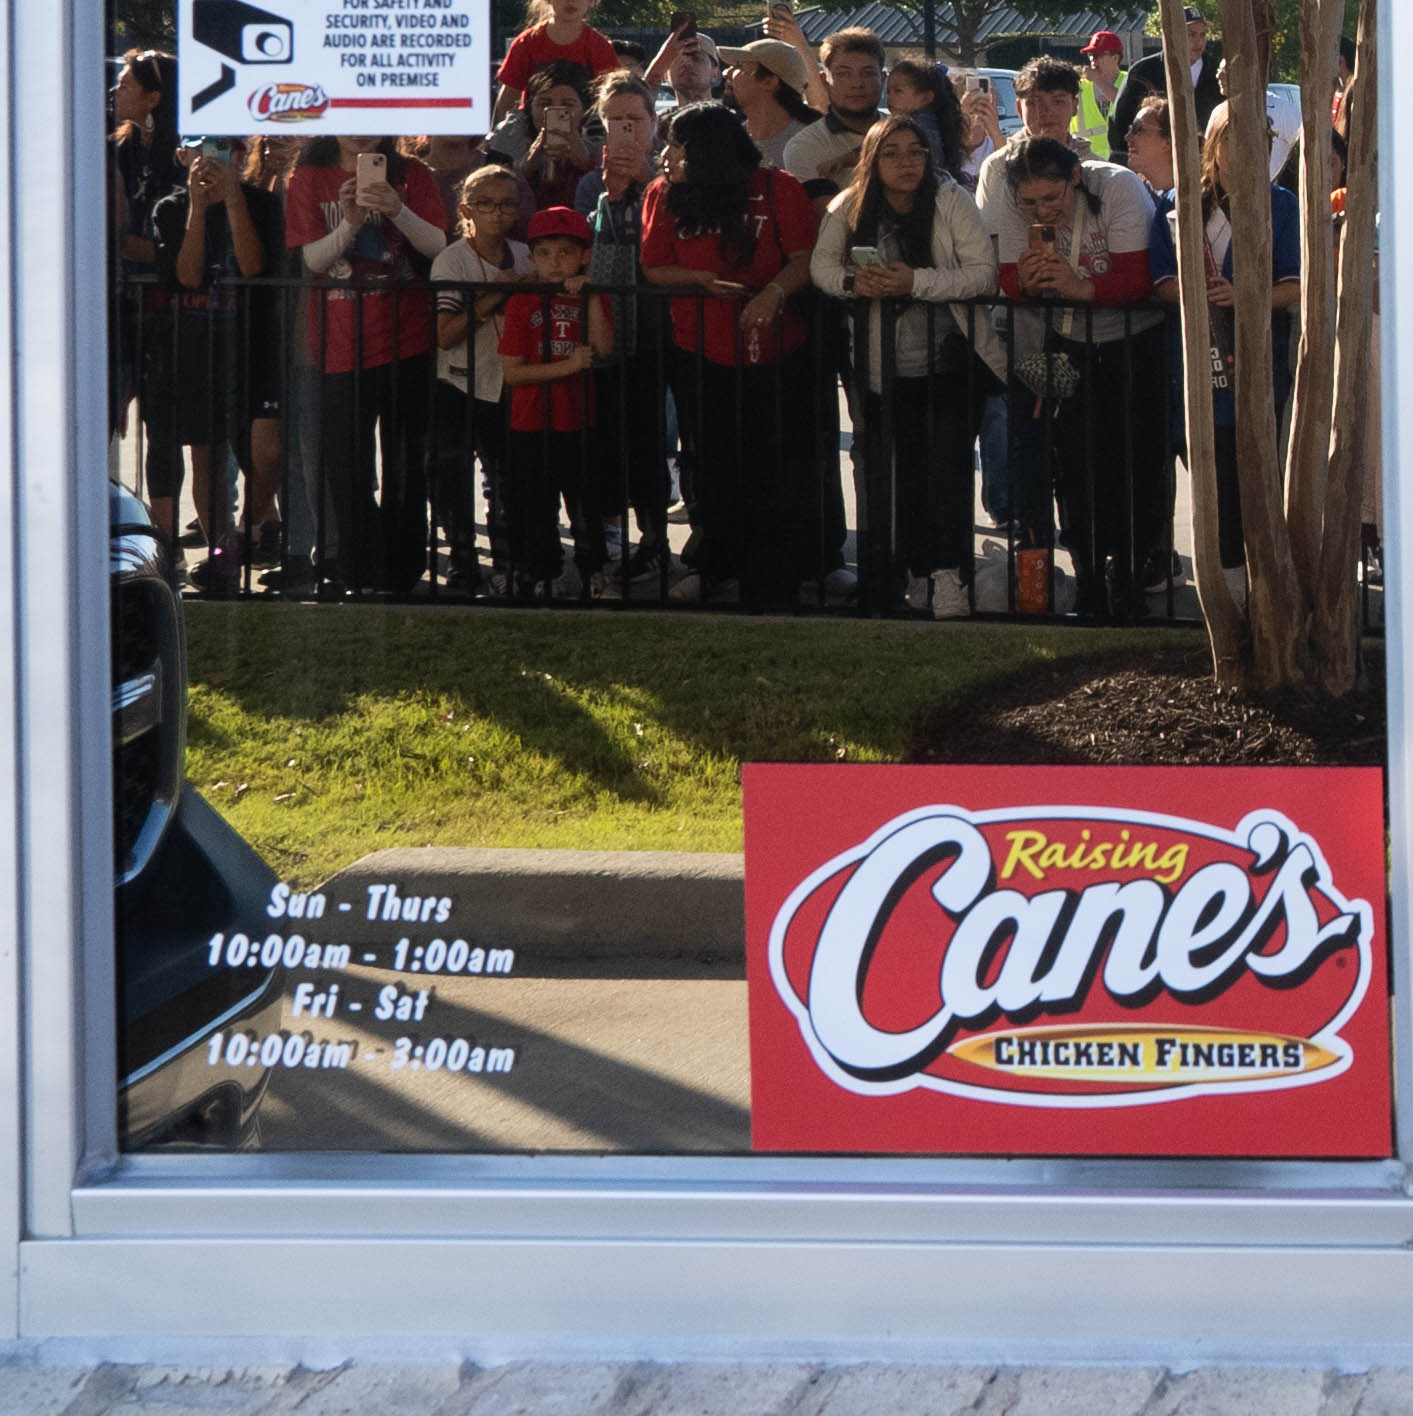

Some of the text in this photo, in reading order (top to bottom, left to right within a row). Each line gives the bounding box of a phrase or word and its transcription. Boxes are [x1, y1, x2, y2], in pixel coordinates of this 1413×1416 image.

[323, 33, 472, 48] AUDIO ARE RECORDED
[325, 14, 469, 31] SECURITY, VIDEO AND
[340, 53, 455, 67] FOR ALL ACTIVITY
[356, 72, 439, 86] ON PREMISE
[1000, 830, 1190, 883] Raising
[266, 882, 327, 919] Sun
[366, 884, 452, 923] Thurs
[208, 933, 351, 969] 10:00am
[394, 937, 515, 974] 1:00am
[808, 813, 1362, 1082] Cane's
[291, 982, 340, 1019] Fri
[374, 984, 429, 1022] Sat
[207, 1033, 351, 1069] 10:00am
[390, 1037, 515, 1074] 3:00am
[994, 1036, 1303, 1070] CHICKEN FINGERS
